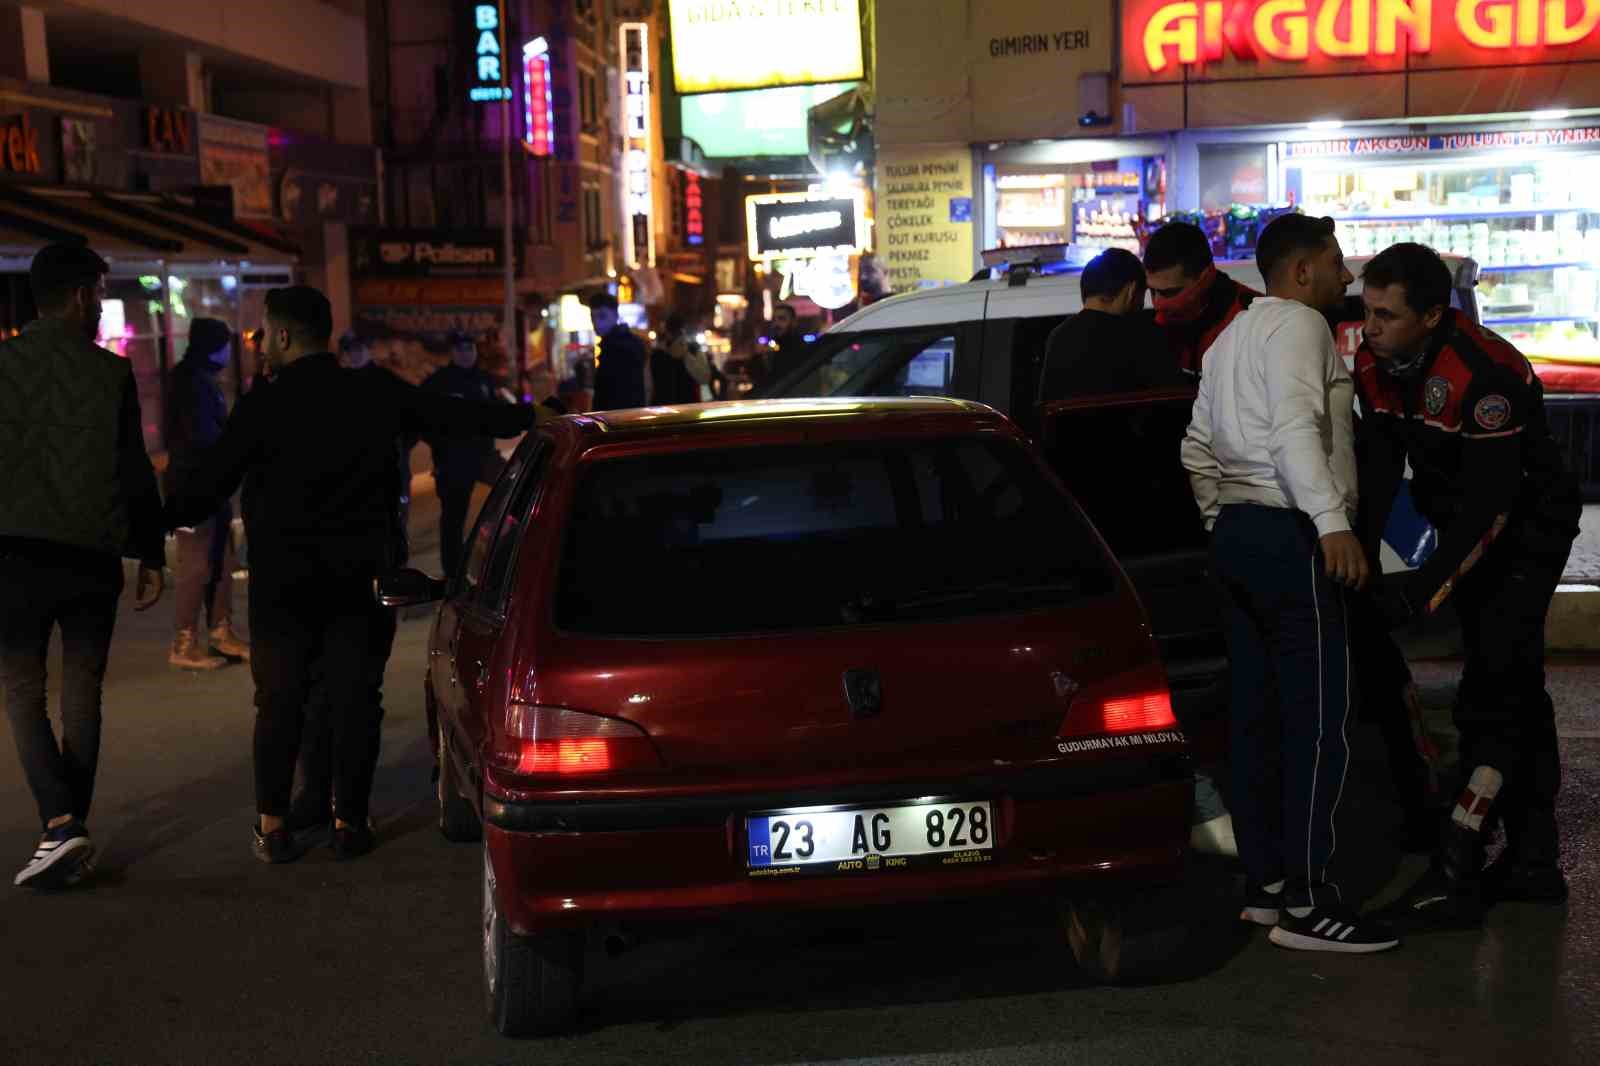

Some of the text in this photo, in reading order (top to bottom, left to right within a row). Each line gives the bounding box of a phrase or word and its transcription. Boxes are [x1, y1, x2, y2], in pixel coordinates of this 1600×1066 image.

[475, 5, 500, 80] BAR
[888, 231, 959, 245] DUT KURUSU
[888, 249, 929, 261] PEKMEZ
[752, 806, 988, 861] TR 23 AG 828
[838, 856, 908, 871] AUTO KING
